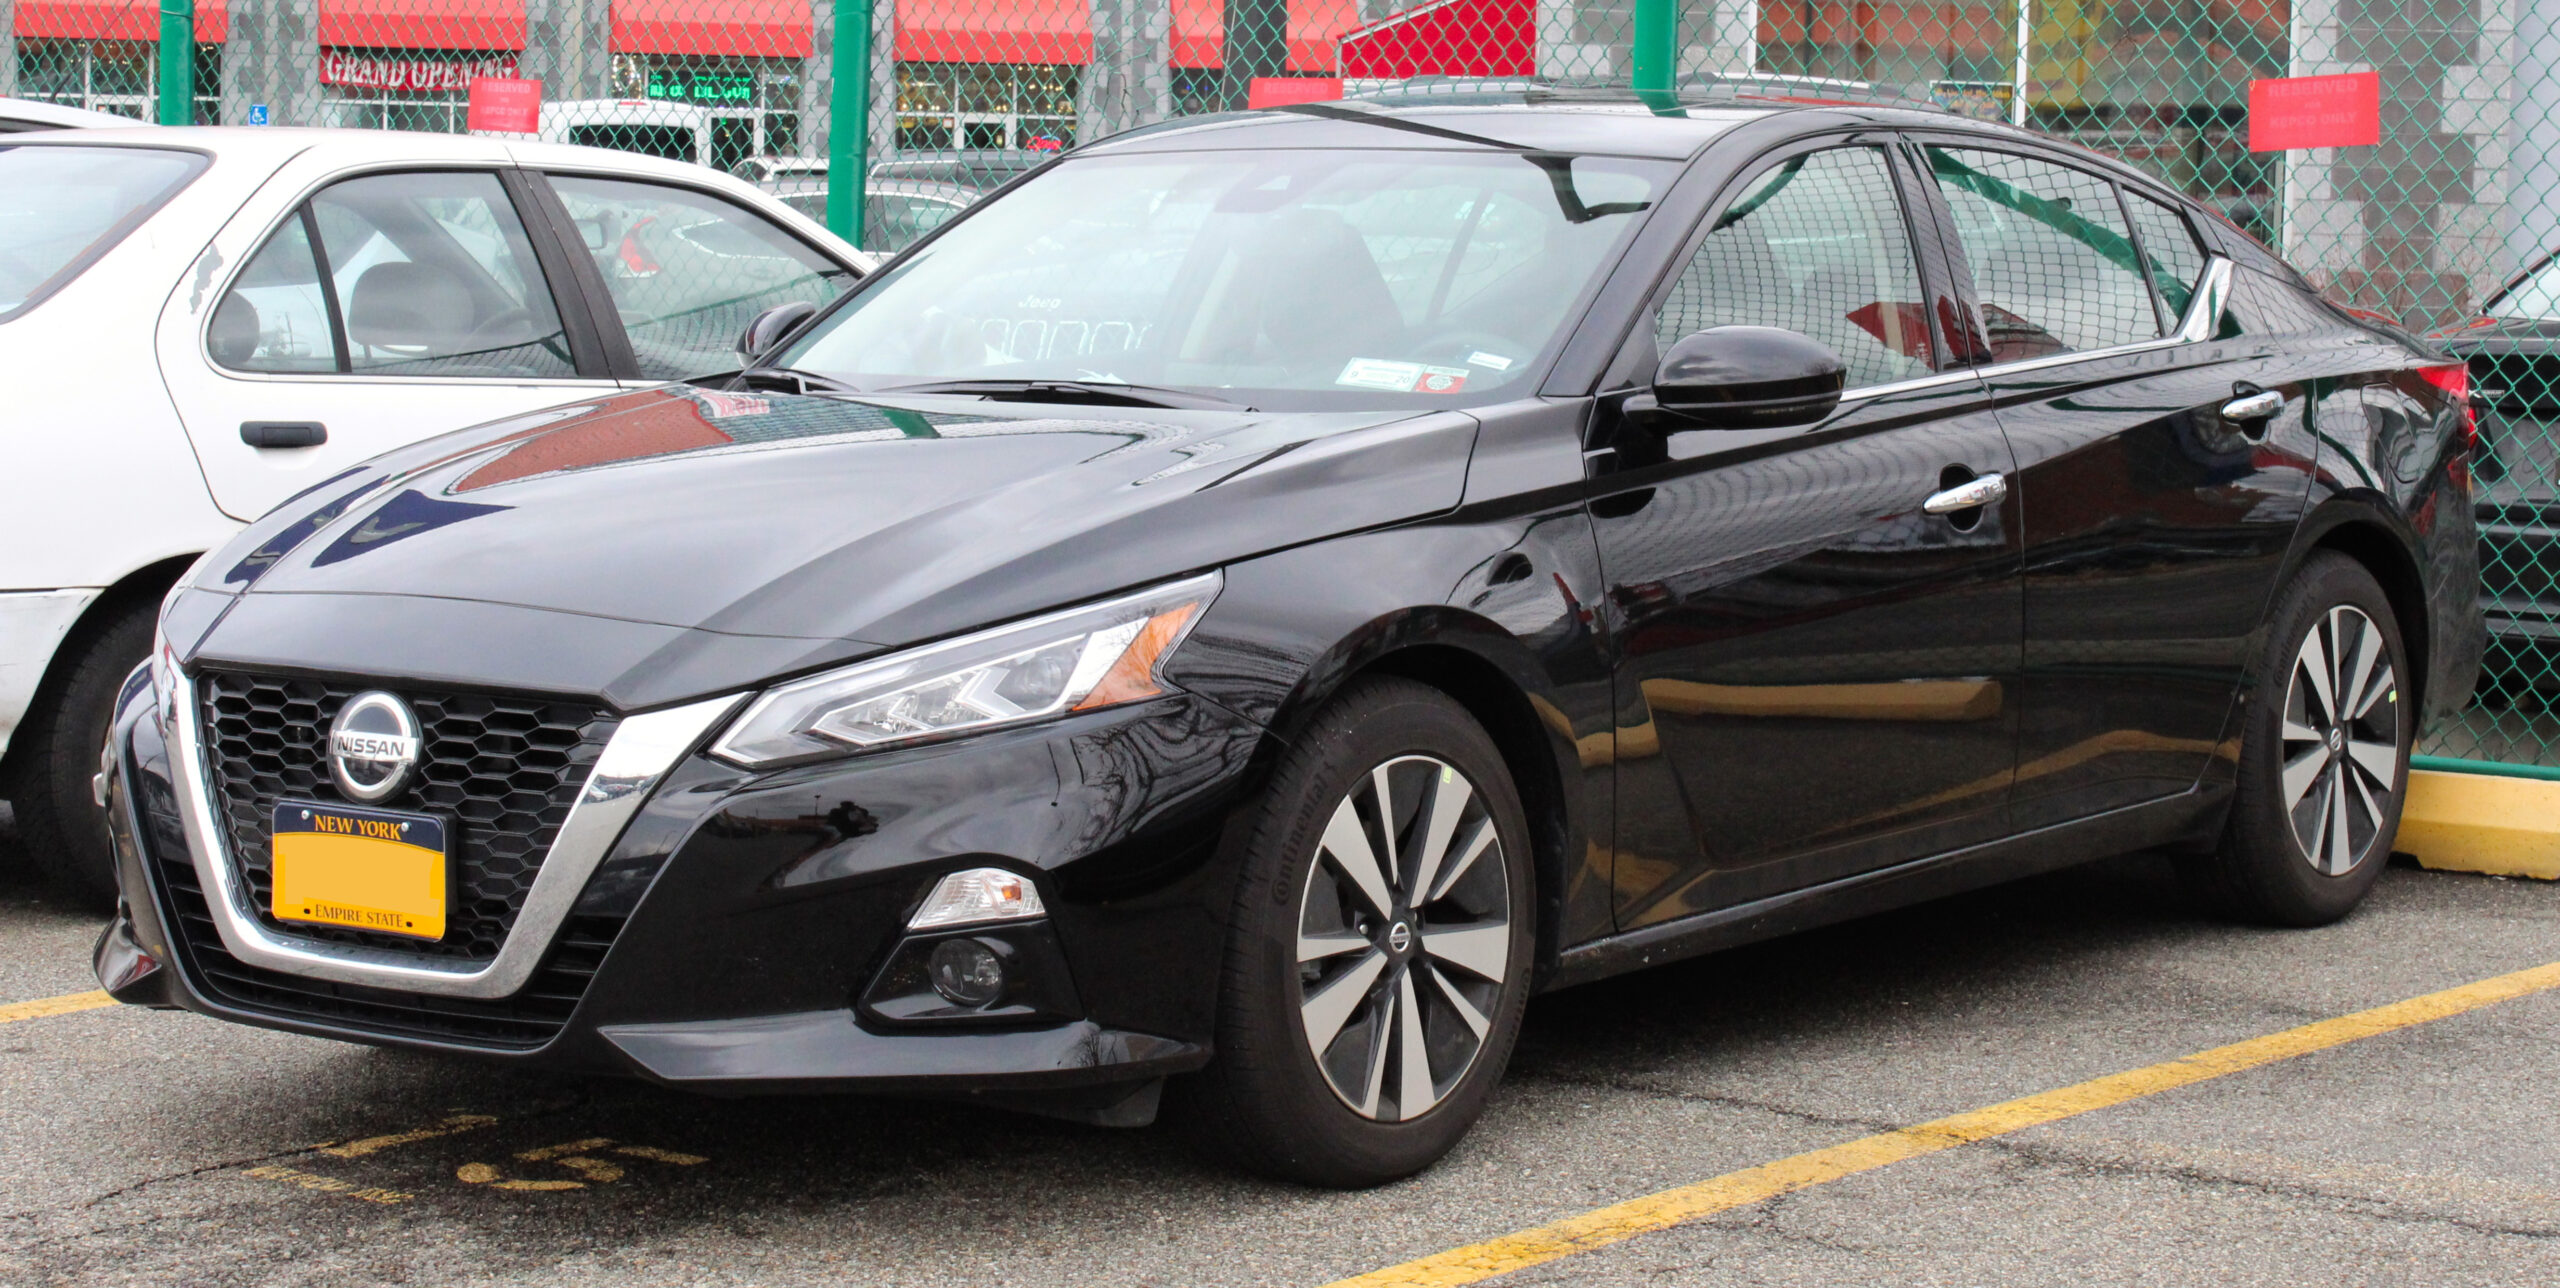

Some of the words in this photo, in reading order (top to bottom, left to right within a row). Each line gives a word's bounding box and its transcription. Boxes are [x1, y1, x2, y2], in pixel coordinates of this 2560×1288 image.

[326, 50, 405, 88] GRAND
[1263, 81, 1328, 94] RESERVED
[2268, 78, 2358, 97] RESERVED
[337, 736, 405, 756] NISSAN
[314, 814, 354, 834] NEW
[357, 819, 402, 841] YORK
[1271, 772, 1330, 907] Continental
[315, 904, 363, 923] EMPIRE
[366, 911, 404, 928] STATE
